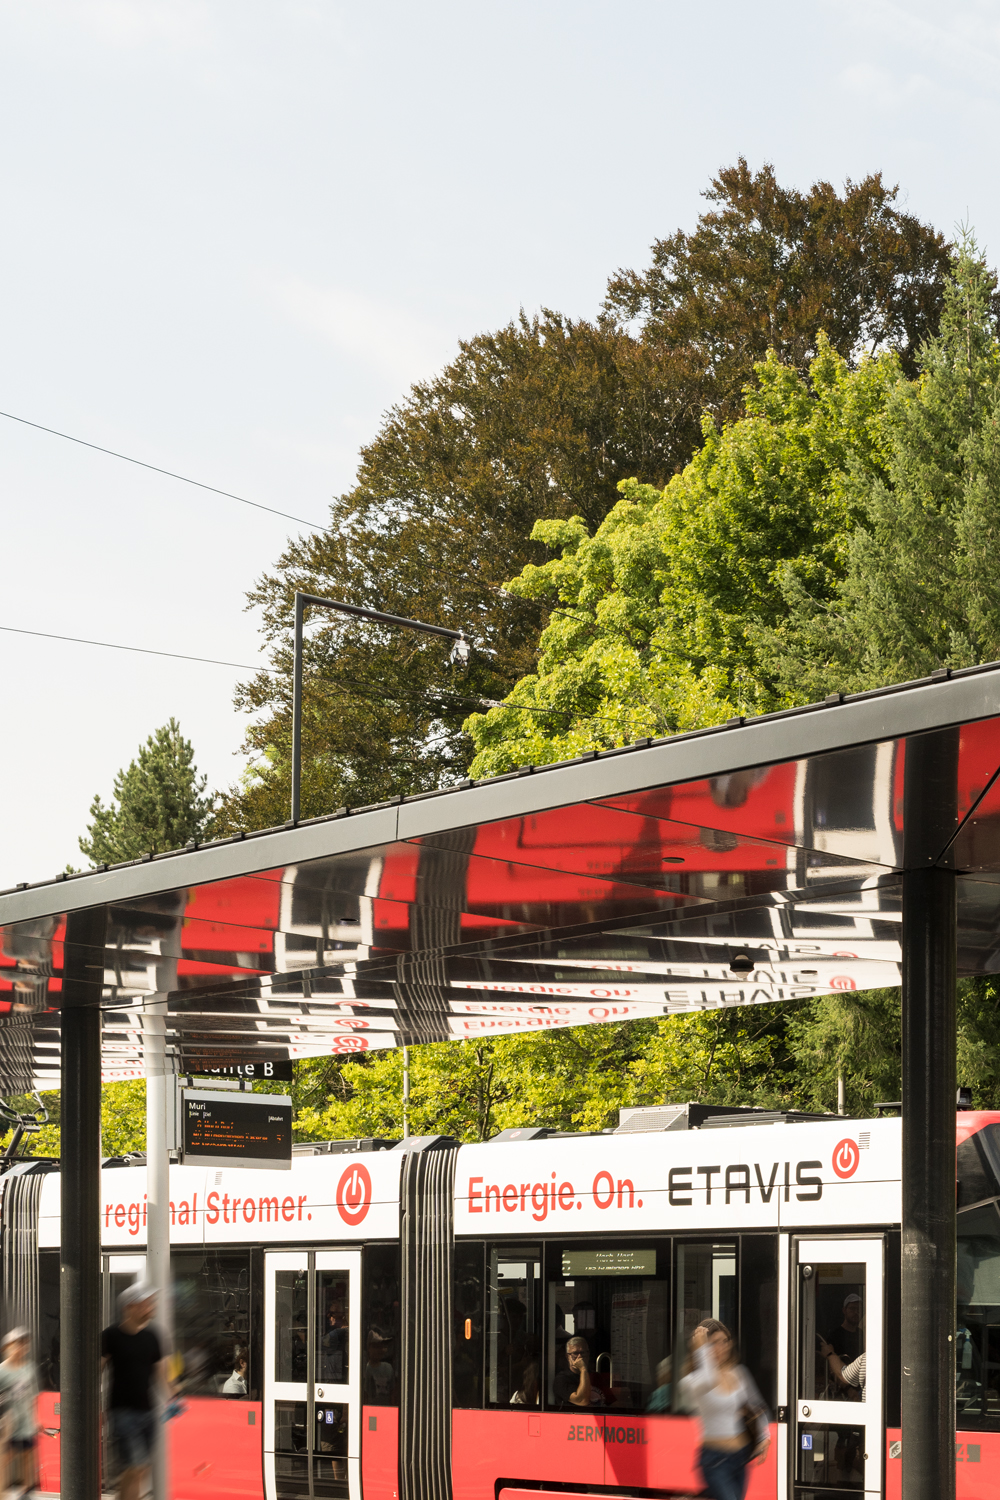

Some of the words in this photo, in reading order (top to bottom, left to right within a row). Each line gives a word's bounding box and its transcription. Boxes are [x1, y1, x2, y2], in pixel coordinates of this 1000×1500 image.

[264, 1062, 274, 1076] B
[189, 1102, 206, 1110] Muri
[468, 1171, 583, 1222] Energie.
[592, 1170, 644, 1210] On.
[668, 1160, 823, 1207] ETAVIS
[105, 1192, 198, 1236] reginal
[206, 1191, 313, 1224] Stromer.
[567, 1424, 649, 1446] BERNMOBIL
